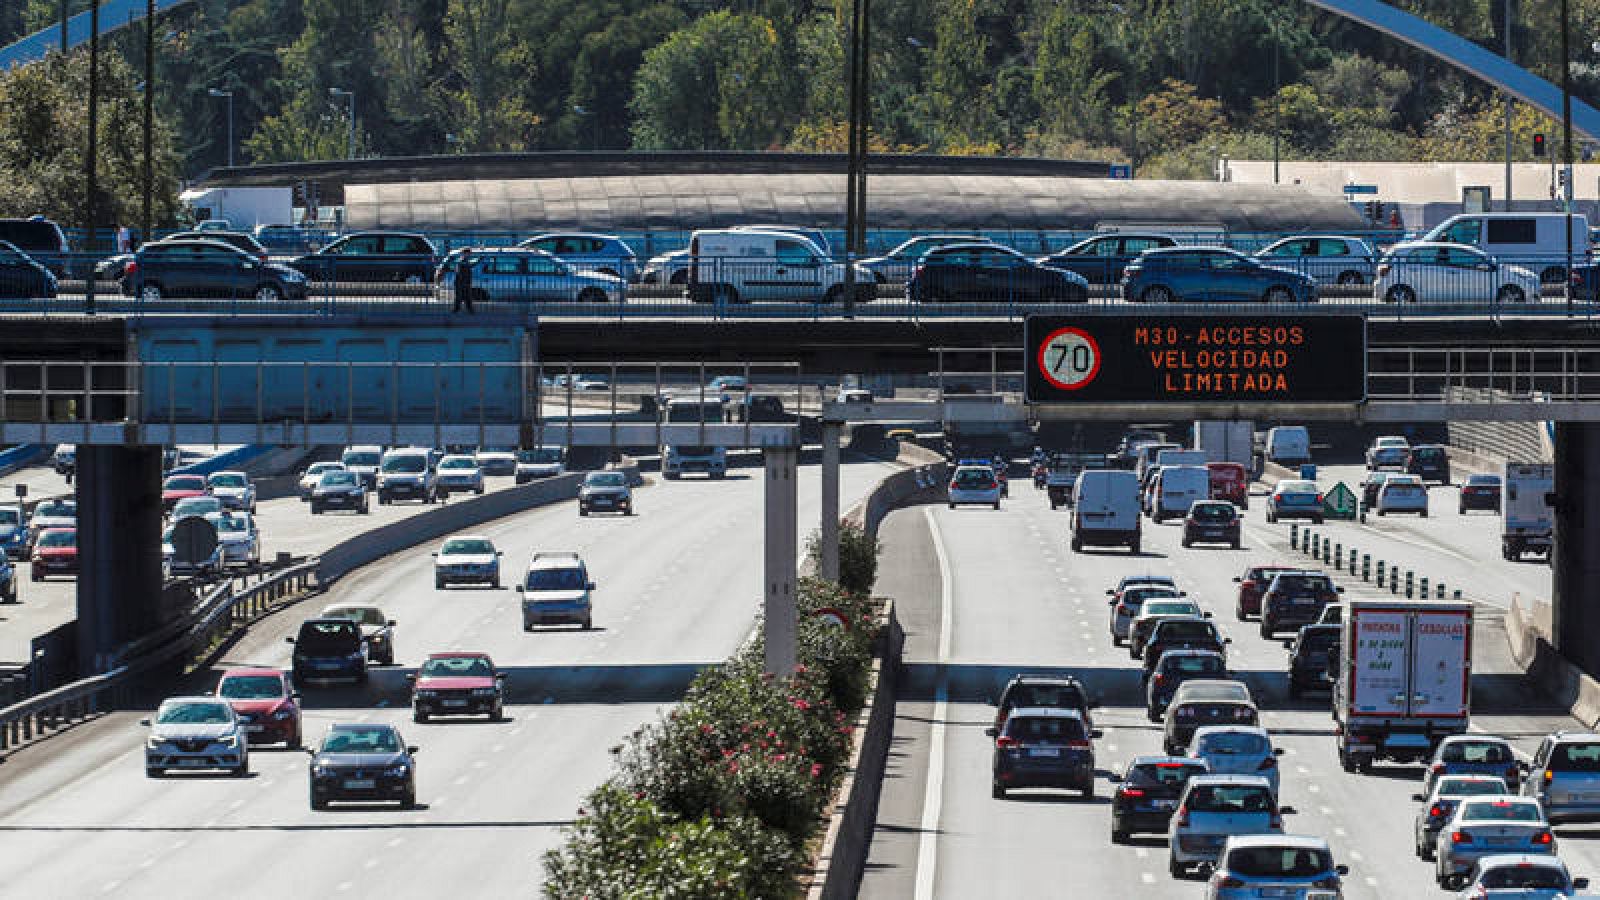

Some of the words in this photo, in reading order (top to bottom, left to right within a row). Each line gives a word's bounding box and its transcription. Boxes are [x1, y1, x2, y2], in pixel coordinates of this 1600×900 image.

[1135, 327, 1304, 345] M30-ACCESOS
[1051, 345, 1089, 373] 70
[1151, 350, 1288, 369] VELOCIDAD
[1166, 373, 1287, 392] LIMITADA
